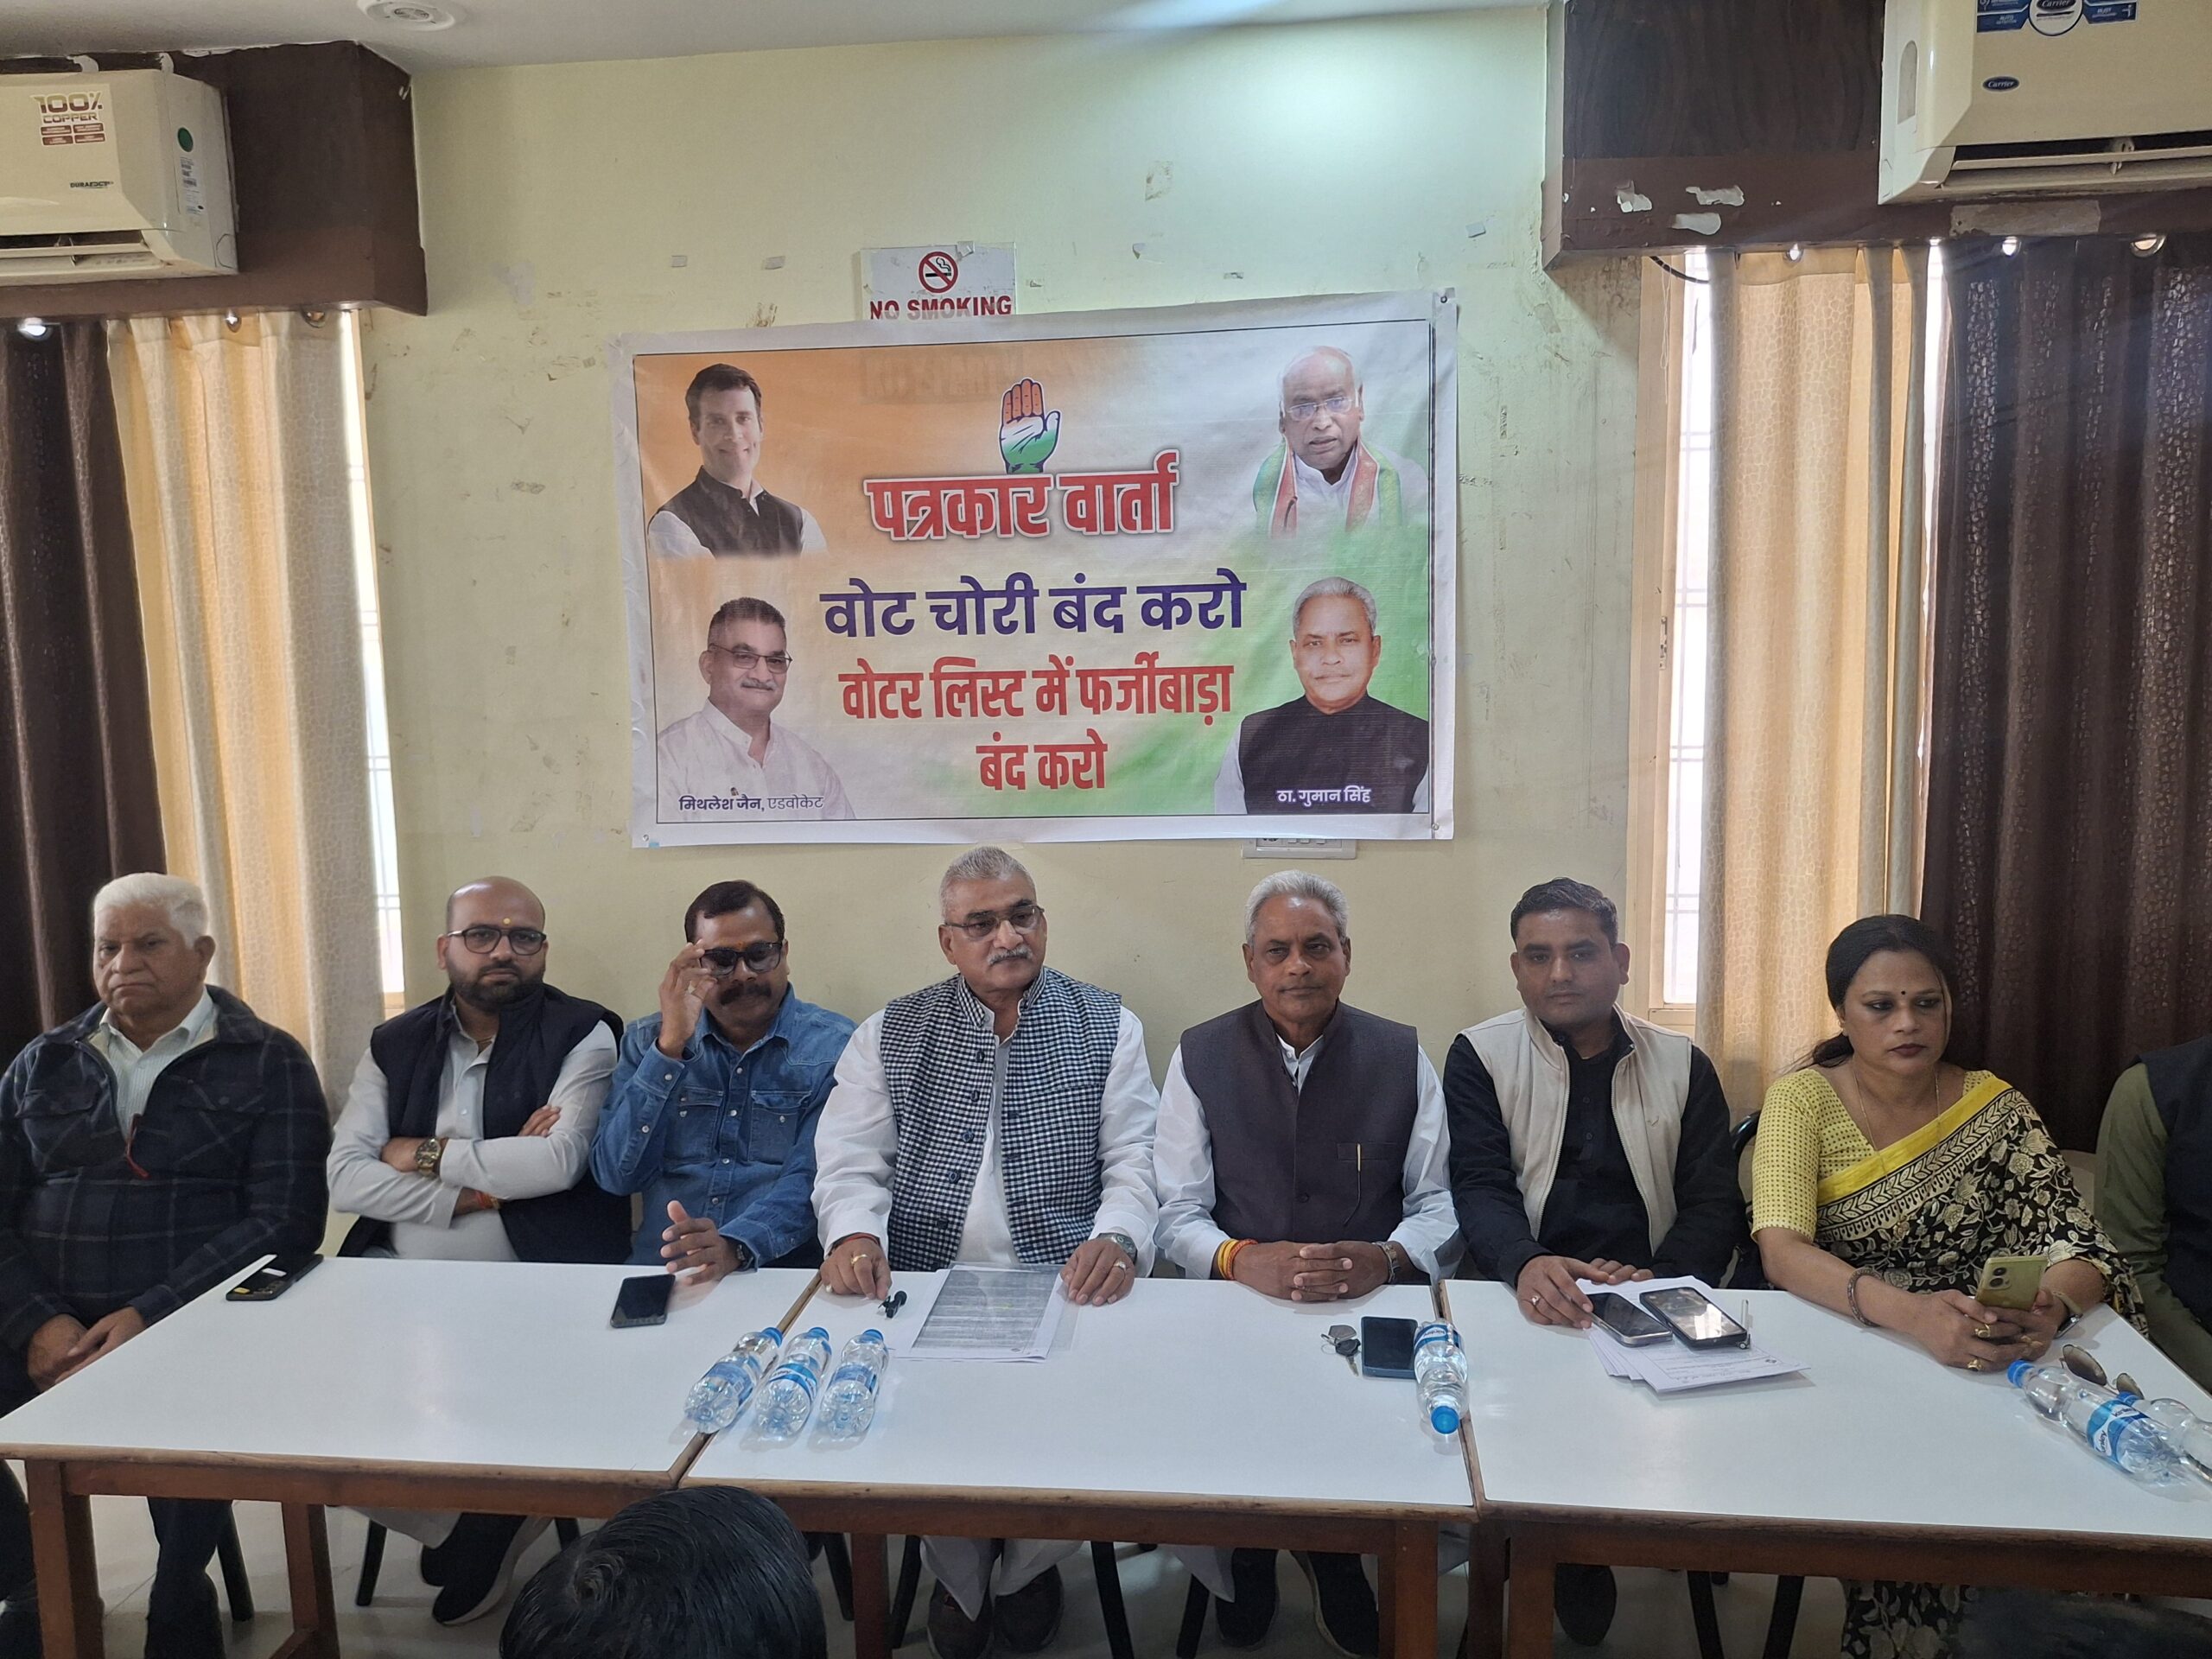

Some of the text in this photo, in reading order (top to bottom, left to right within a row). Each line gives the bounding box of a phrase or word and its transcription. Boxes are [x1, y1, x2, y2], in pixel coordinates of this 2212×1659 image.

[34, 92, 103, 114] 100%
[43, 113, 98, 124] COPPER
[870, 296, 1012, 320] NO SMOKING
[865, 448, 1179, 540] पत्रकार वार्ता
[819, 567, 1247, 638] वोट चोरी बंद करो
[838, 651, 1235, 726] वोटर लिस्ट में फर्जीबाड़ा
[976, 728, 1108, 791] बंद करो
[678, 793, 823, 811] मिथलेश जैन, एडवोकेट
[1276, 785, 1371, 807] ठा. गुमान सिंह
